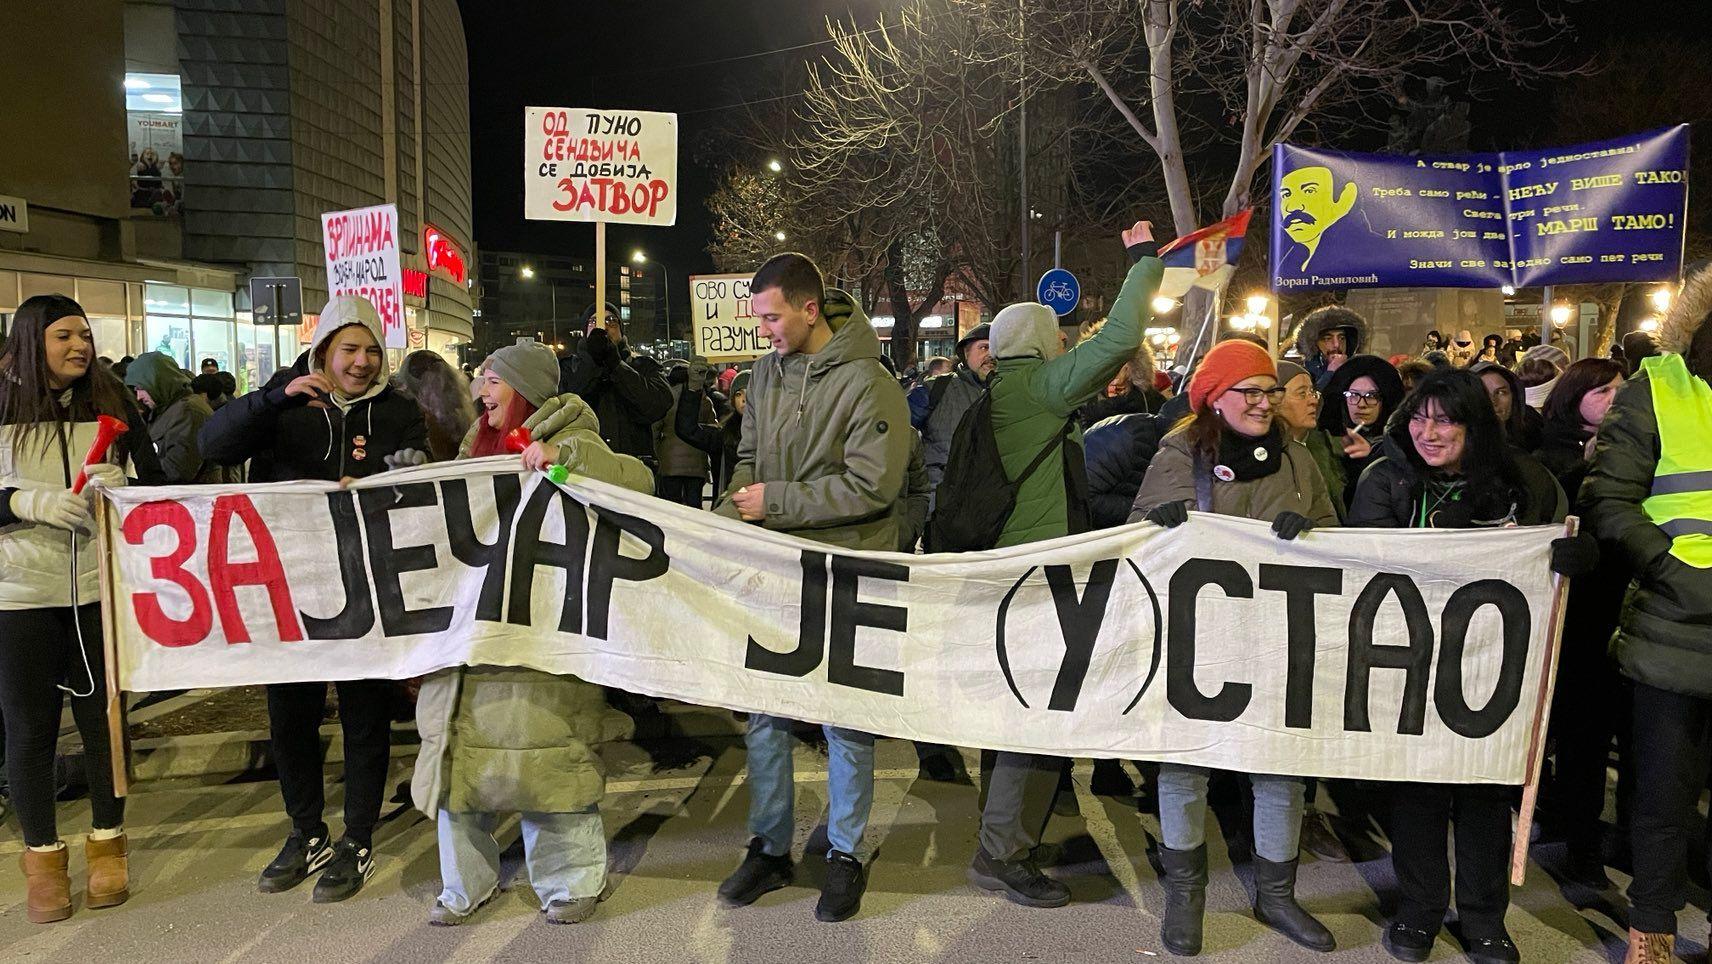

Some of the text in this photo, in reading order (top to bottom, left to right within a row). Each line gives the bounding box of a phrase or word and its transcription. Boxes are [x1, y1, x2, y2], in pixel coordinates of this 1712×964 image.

[137, 120, 178, 128] YOUMART
[543, 111, 642, 137] ОД ПУНО
[543, 138, 641, 162] СЕНДВИЧА
[1416, 143, 1641, 175] А ствар је врло једноставна!
[538, 162, 652, 180] СЕ ДОБИЈА
[552, 177, 669, 217] ЗАТВОР
[1372, 187, 1412, 198] Треба
[1419, 188, 1450, 198] само
[1456, 190, 1487, 201] рећи
[1508, 181, 1559, 201] НЕЋУ
[1570, 173, 1623, 191] ВИШЕ
[0, 203, 16, 223] N
[1463, 209, 1502, 220] Свега
[1508, 208, 1535, 220] три
[1387, 229, 1397, 239] И
[1403, 229, 1445, 239] можда
[1452, 228, 1477, 240] још
[1483, 231, 1506, 240] две
[1536, 217, 1599, 236] МАРШ
[1612, 213, 1674, 231] ТАМО!
[356, 256, 387, 287] НАРОД
[1409, 252, 1664, 271] Значи све заједно само пет речи
[696, 281, 726, 300] ОВО
[1275, 273, 1378, 288] Зоран Радмиловић
[123, 473, 1531, 739] ЗАЈЕЧАР ЈЕ (У)СТАО
